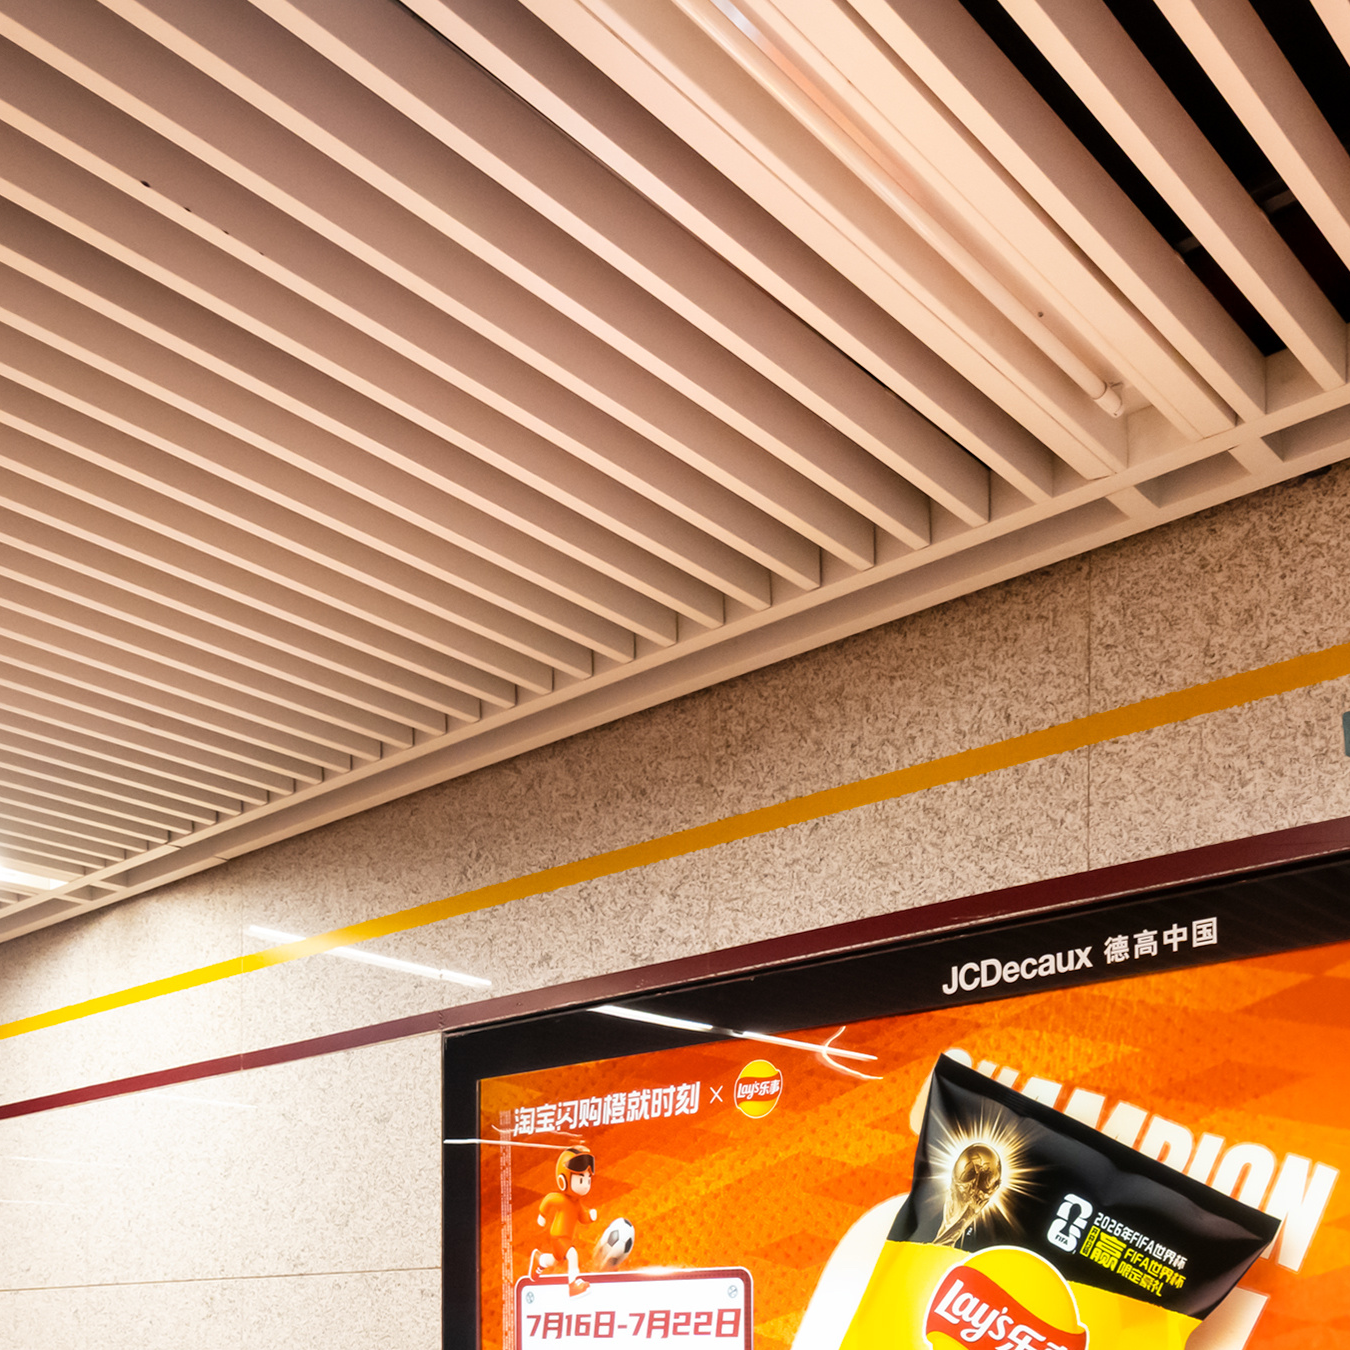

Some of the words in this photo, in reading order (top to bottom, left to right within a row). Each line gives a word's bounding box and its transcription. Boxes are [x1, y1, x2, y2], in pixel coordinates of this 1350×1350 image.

[942, 946, 1092, 995] JCDecaux
[1104, 917, 1217, 964] 德高中国
[513, 1081, 701, 1137] 淘宝闪购橙就时刻
[1094, 1212, 1188, 1270] 2026年FIFA世界杯
[1124, 1248, 1186, 1288] FIFA世界杯
[526, 1308, 741, 1339] 7月16日-7月22日
